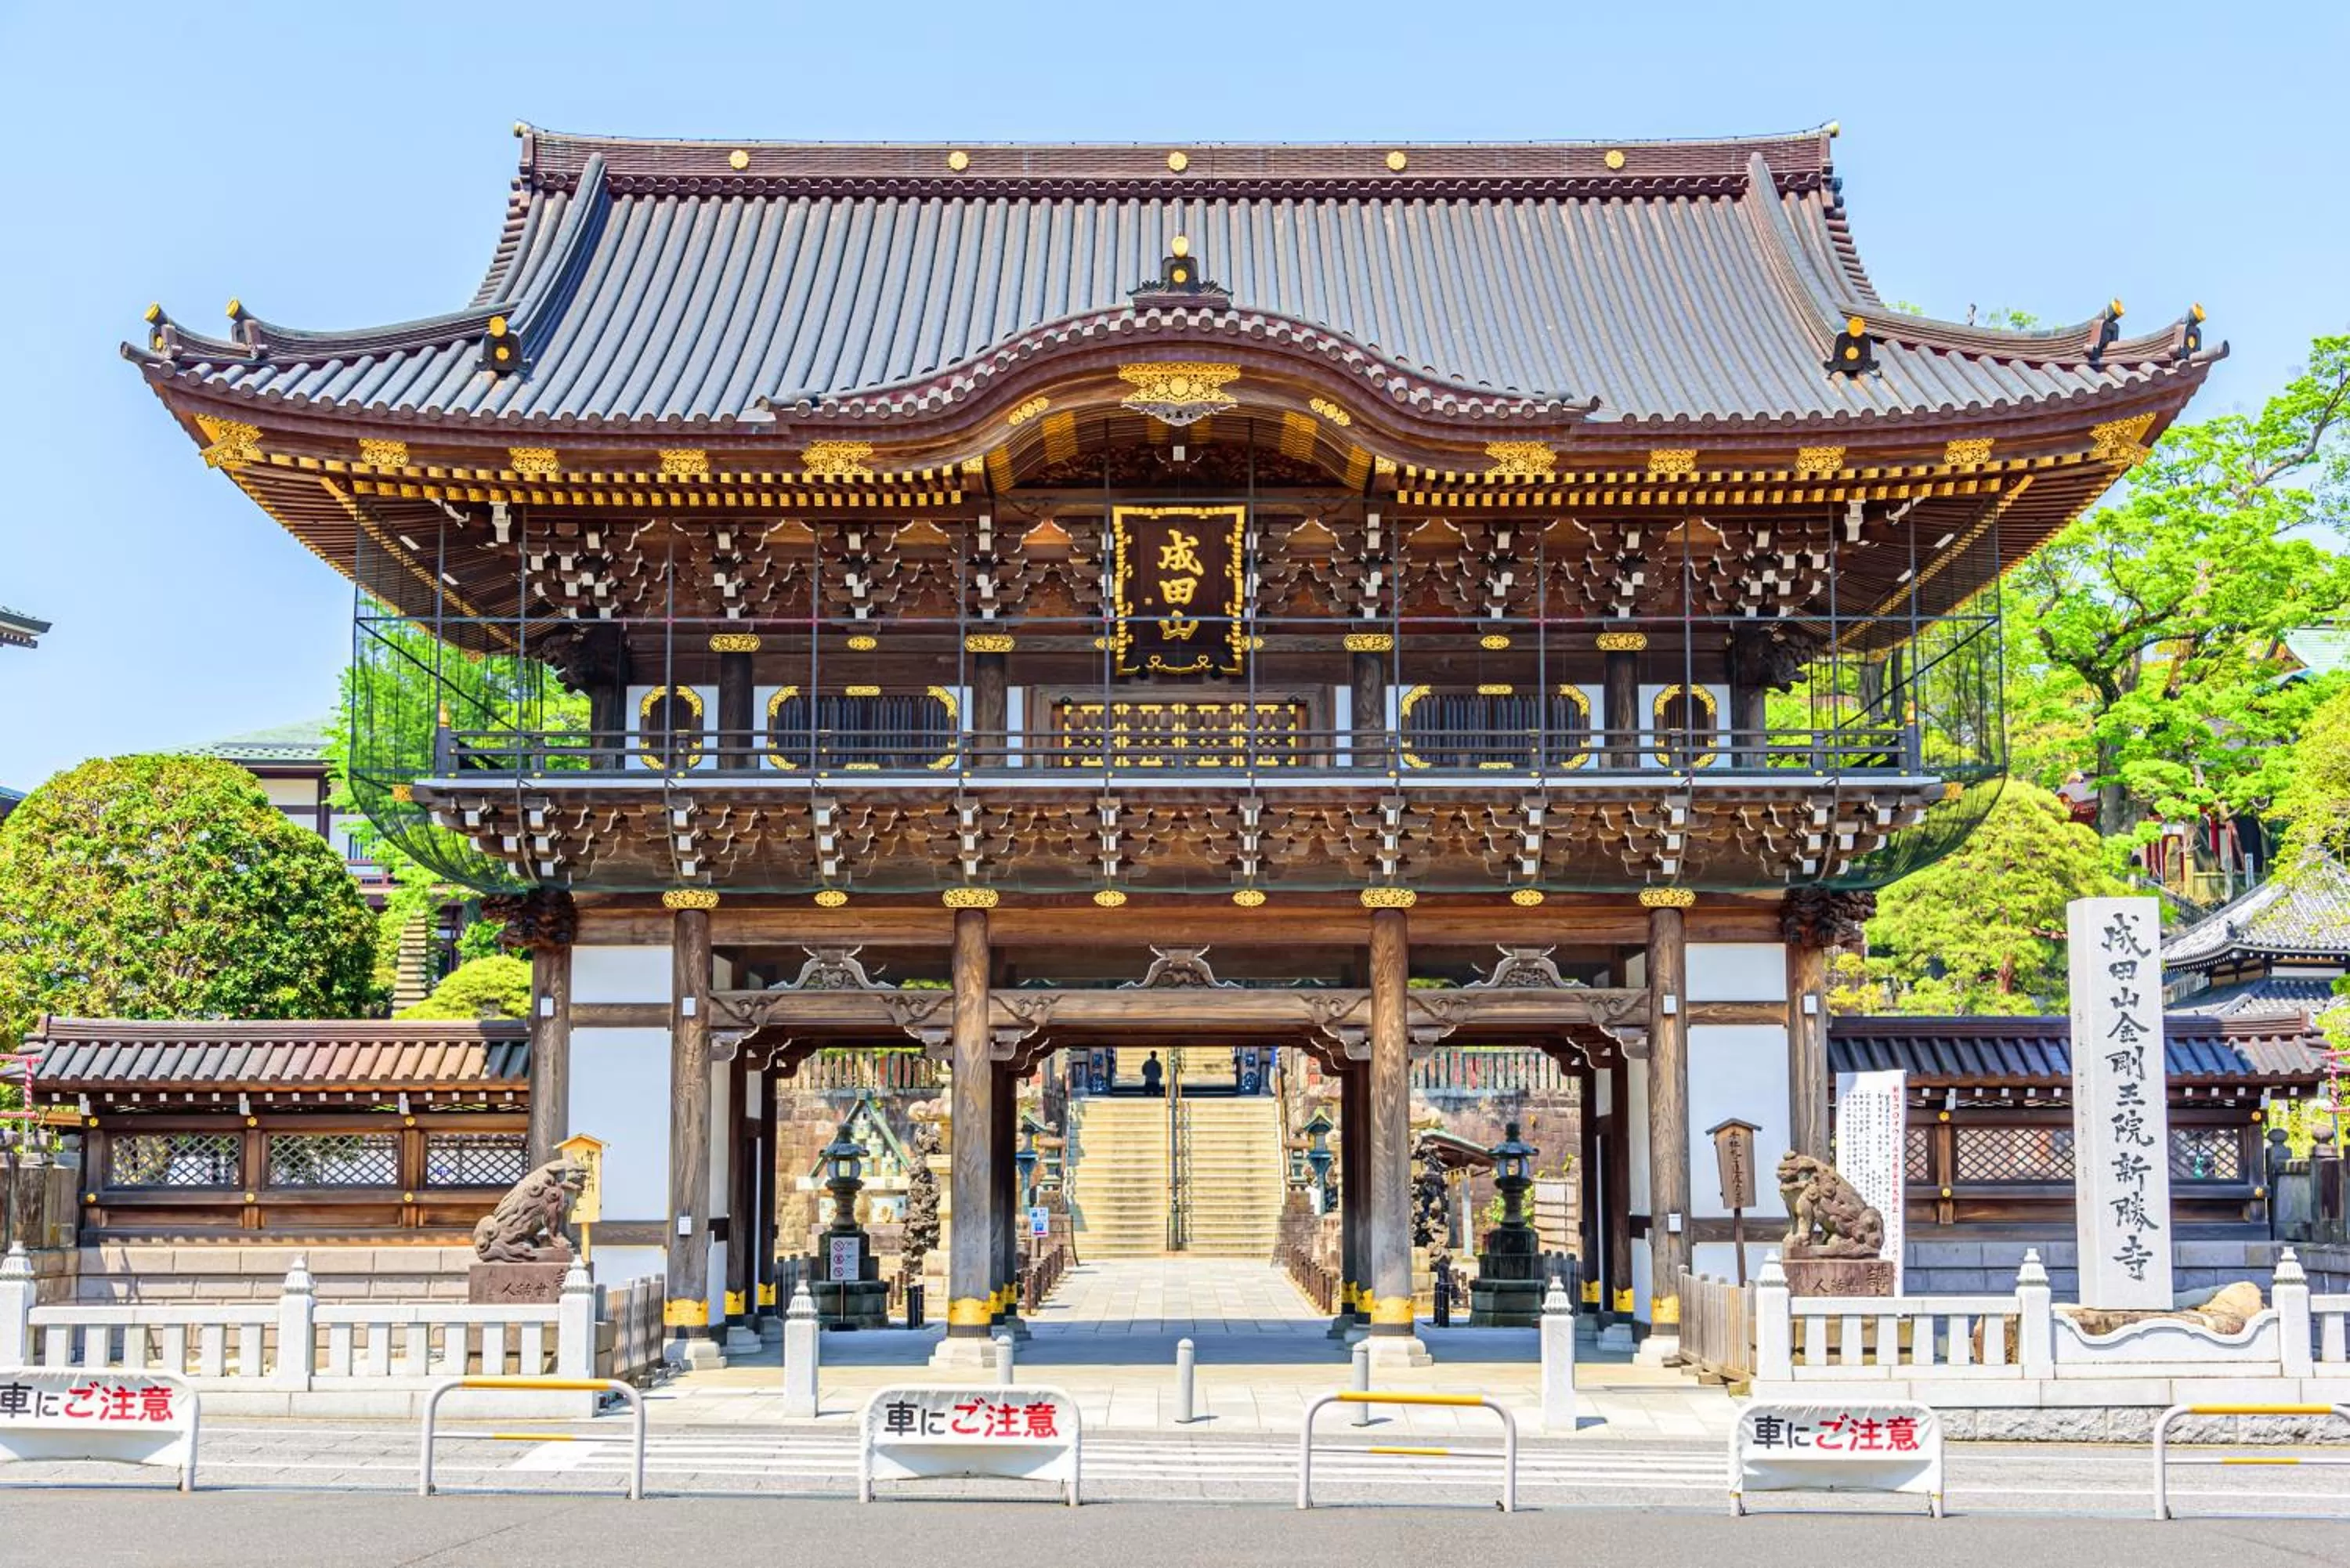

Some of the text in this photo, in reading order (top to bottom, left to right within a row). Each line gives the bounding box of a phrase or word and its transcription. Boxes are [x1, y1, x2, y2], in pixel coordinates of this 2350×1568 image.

[1156, 529, 1205, 641] 成田山
[2101, 912, 2160, 1281] 成田山金剛王院新勝寺
[0, 1382, 173, 1422] 車にご注意
[884, 1397, 1059, 1439] 車にご注意
[1752, 1413, 1920, 1451] 車にご注意
